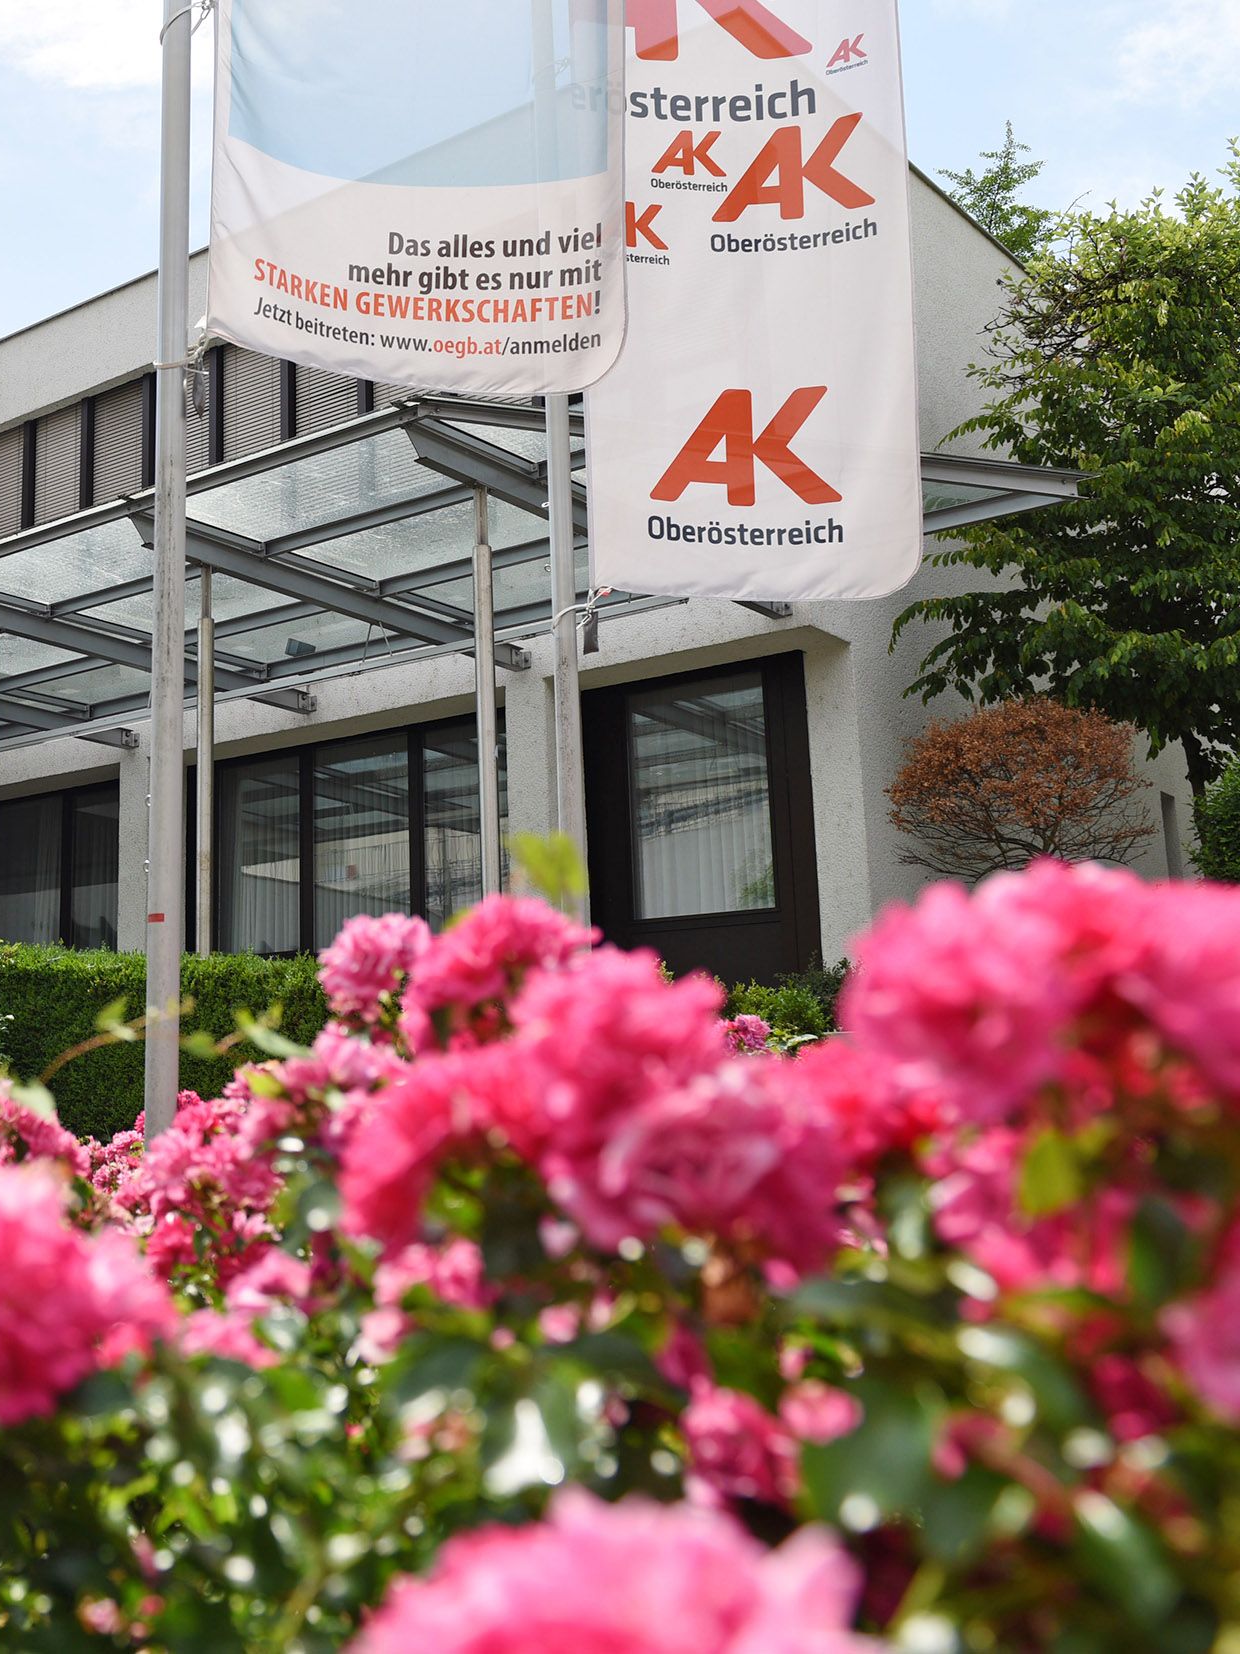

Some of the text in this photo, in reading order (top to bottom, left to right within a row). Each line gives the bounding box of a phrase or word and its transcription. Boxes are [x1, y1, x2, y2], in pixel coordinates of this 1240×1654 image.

[826, 33, 867, 68] AK
[651, 130, 727, 177] AK
[711, 112, 876, 223] AK
[650, 178, 728, 193] Oberösterreich
[388, 223, 602, 258] Das alles und viel
[625, 201, 669, 250] K
[710, 218, 878, 253] Oberösterreich
[348, 258, 602, 295] mehr gibt es nur mit
[626, 253, 670, 265] sterreich
[254, 258, 601, 324] STARKEN GEWERKSCHAFTEN!
[254, 297, 601, 359] Jetzt beitreten: www.oegb.at/anmelden
[649, 385, 843, 506] AK
[647, 515, 844, 545] Oberösterreich
